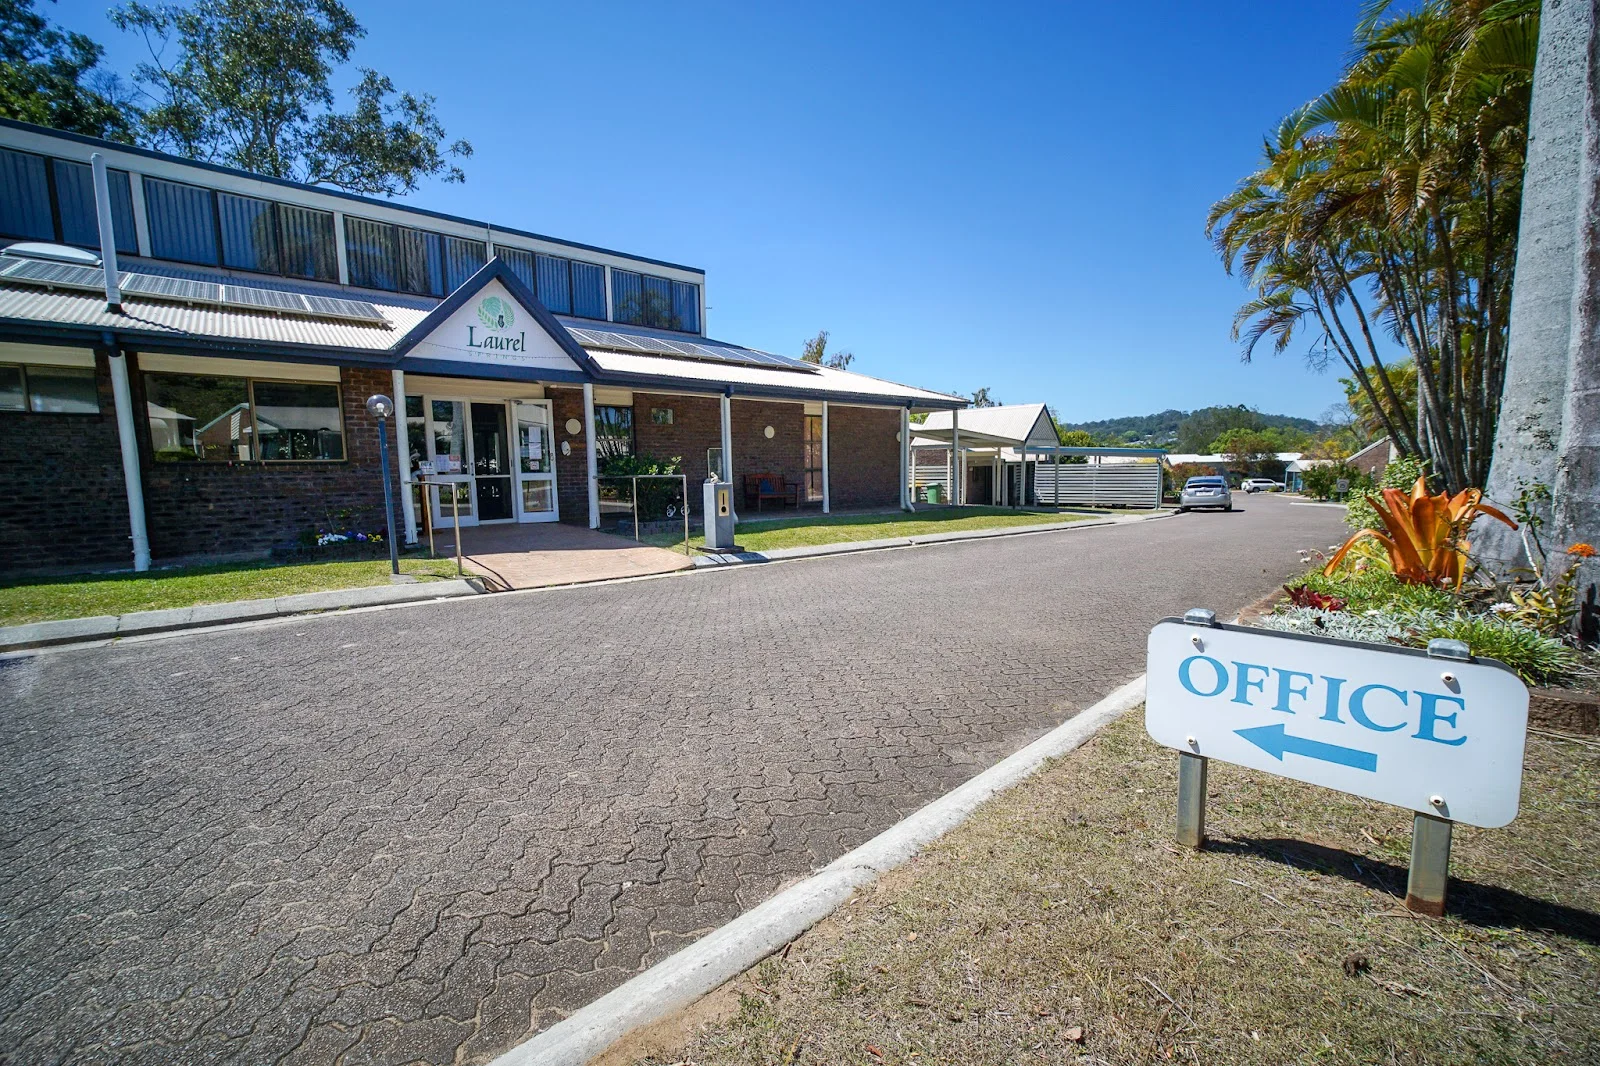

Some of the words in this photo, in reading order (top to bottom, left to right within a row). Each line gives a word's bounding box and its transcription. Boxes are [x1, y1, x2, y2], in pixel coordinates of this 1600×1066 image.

[466, 325, 526, 352] Laurel
[468, 350, 526, 361] SPRINGS
[1178, 655, 1468, 746] OFFICE
